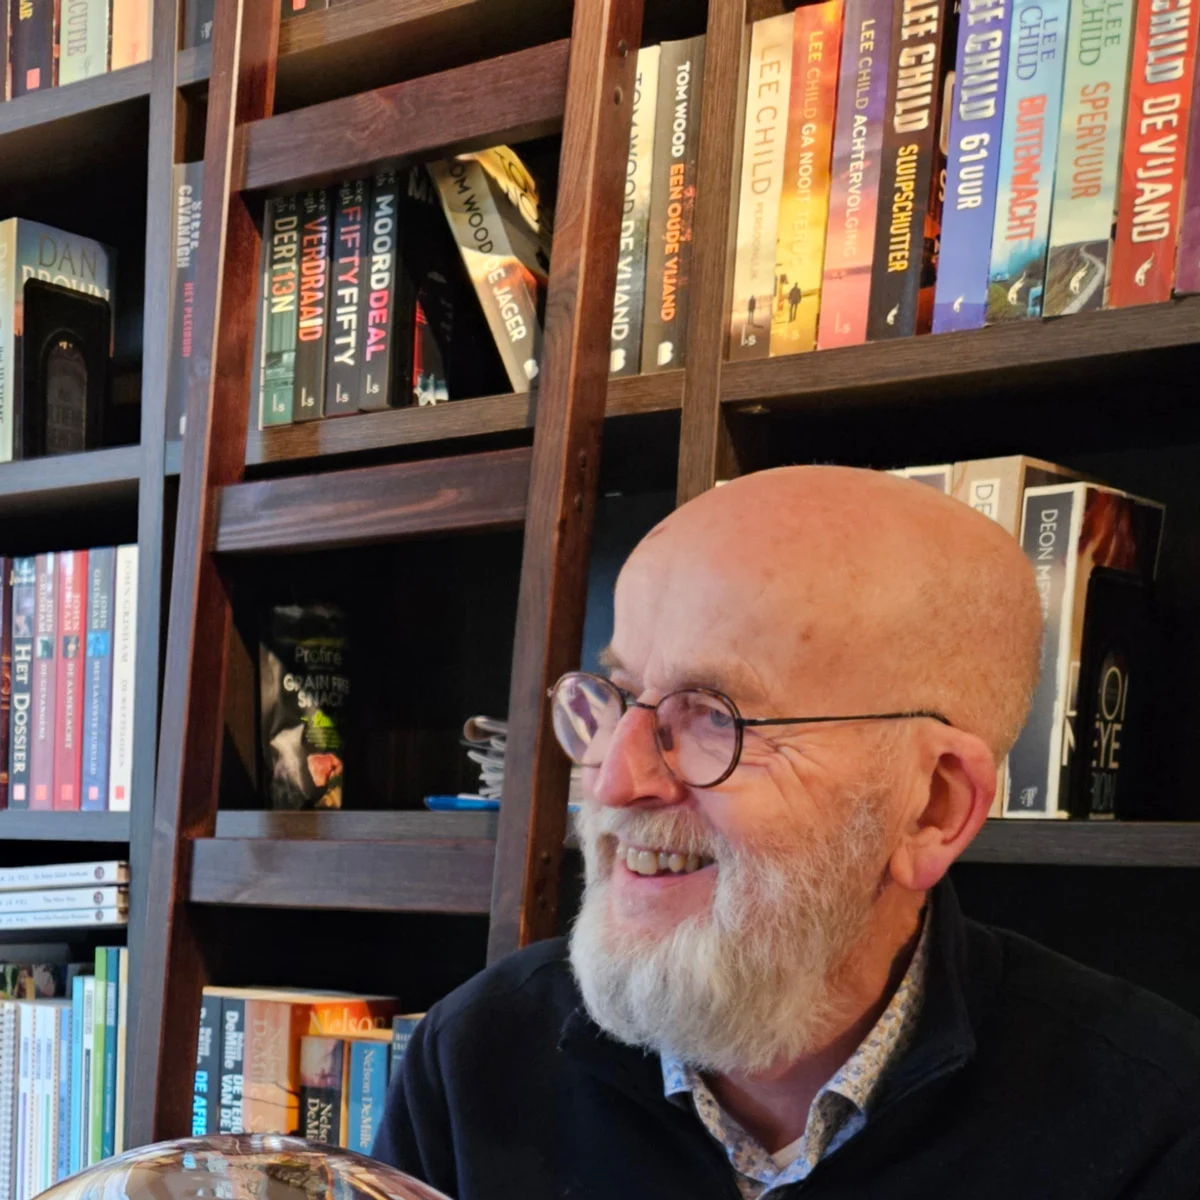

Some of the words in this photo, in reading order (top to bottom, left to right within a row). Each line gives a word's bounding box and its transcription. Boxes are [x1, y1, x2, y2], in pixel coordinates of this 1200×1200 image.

[19, 0, 34, 21] AR
[66, 0, 89, 57] CUTIE
[900, 0, 940, 42] LEE
[965, 0, 1006, 26] EE
[1103, 2, 1124, 48] LEE
[806, 30, 825, 63] LEE
[859, 19, 877, 53] LEE
[1015, 5, 1045, 82] CHILD
[1040, 15, 1060, 63] LEE
[675, 61, 691, 101] TOM
[756, 44, 782, 99] LEE
[801, 67, 821, 118] CHILD
[853, 57, 873, 110] CHILD
[893, 42, 937, 135] CHILD
[958, 29, 1003, 122] CHILD
[670, 102, 689, 159] WOOD
[799, 122, 817, 149] GA
[1140, 93, 1183, 134] DE
[750, 105, 777, 196] CHILD
[959, 132, 991, 163] 61
[1069, 81, 1112, 201] SPERVUUR
[449, 163, 473, 195] OM
[668, 162, 685, 201] EEN
[797, 152, 816, 206] NOOIT
[841, 114, 869, 258] ACHTERVOLGING
[956, 164, 985, 211] UUR
[1004, 94, 1049, 242] BUITENWACHT
[1130, 133, 1179, 243] VIJAND
[176, 184, 194, 269] CAVANAGH
[463, 193, 494, 254] WOOD
[664, 202, 682, 256] OUDE
[887, 144, 919, 273] SLUIPSCHUTTER
[38, 233, 98, 282] DAN
[270, 215, 298, 315] DERT13N
[787, 212, 809, 269] TERUG
[183, 282, 195, 305] HET
[298, 215, 329, 342] VERDRAAID
[365, 194, 396, 362] MOORDDEAL
[482, 260, 507, 285] DE
[660, 256, 679, 322] VIJAND
[492, 284, 529, 343] JAGER
[975, 483, 996, 517] DE
[1037, 508, 1060, 562] DEON
[91, 568, 102, 630] GRISHAM
[99, 595, 109, 630] JOHN
[14, 643, 32, 684] HET
[13, 691, 31, 774] DOSSIER
[224, 1009, 240, 1070] DeMille
[308, 1007, 386, 1035] Nelson
[193, 1070, 209, 1094] DE
[220, 1073, 233, 1104] VAN
[231, 1073, 244, 1094] DE
[361, 1048, 377, 1094] Nelson
[191, 1094, 208, 1138] AFRE
[220, 1107, 232, 1128] DE
[230, 1098, 244, 1134] TERU
[306, 1097, 320, 1140] DeMi
[319, 1103, 333, 1144] Nelso
[358, 1096, 374, 1148] DeMille
